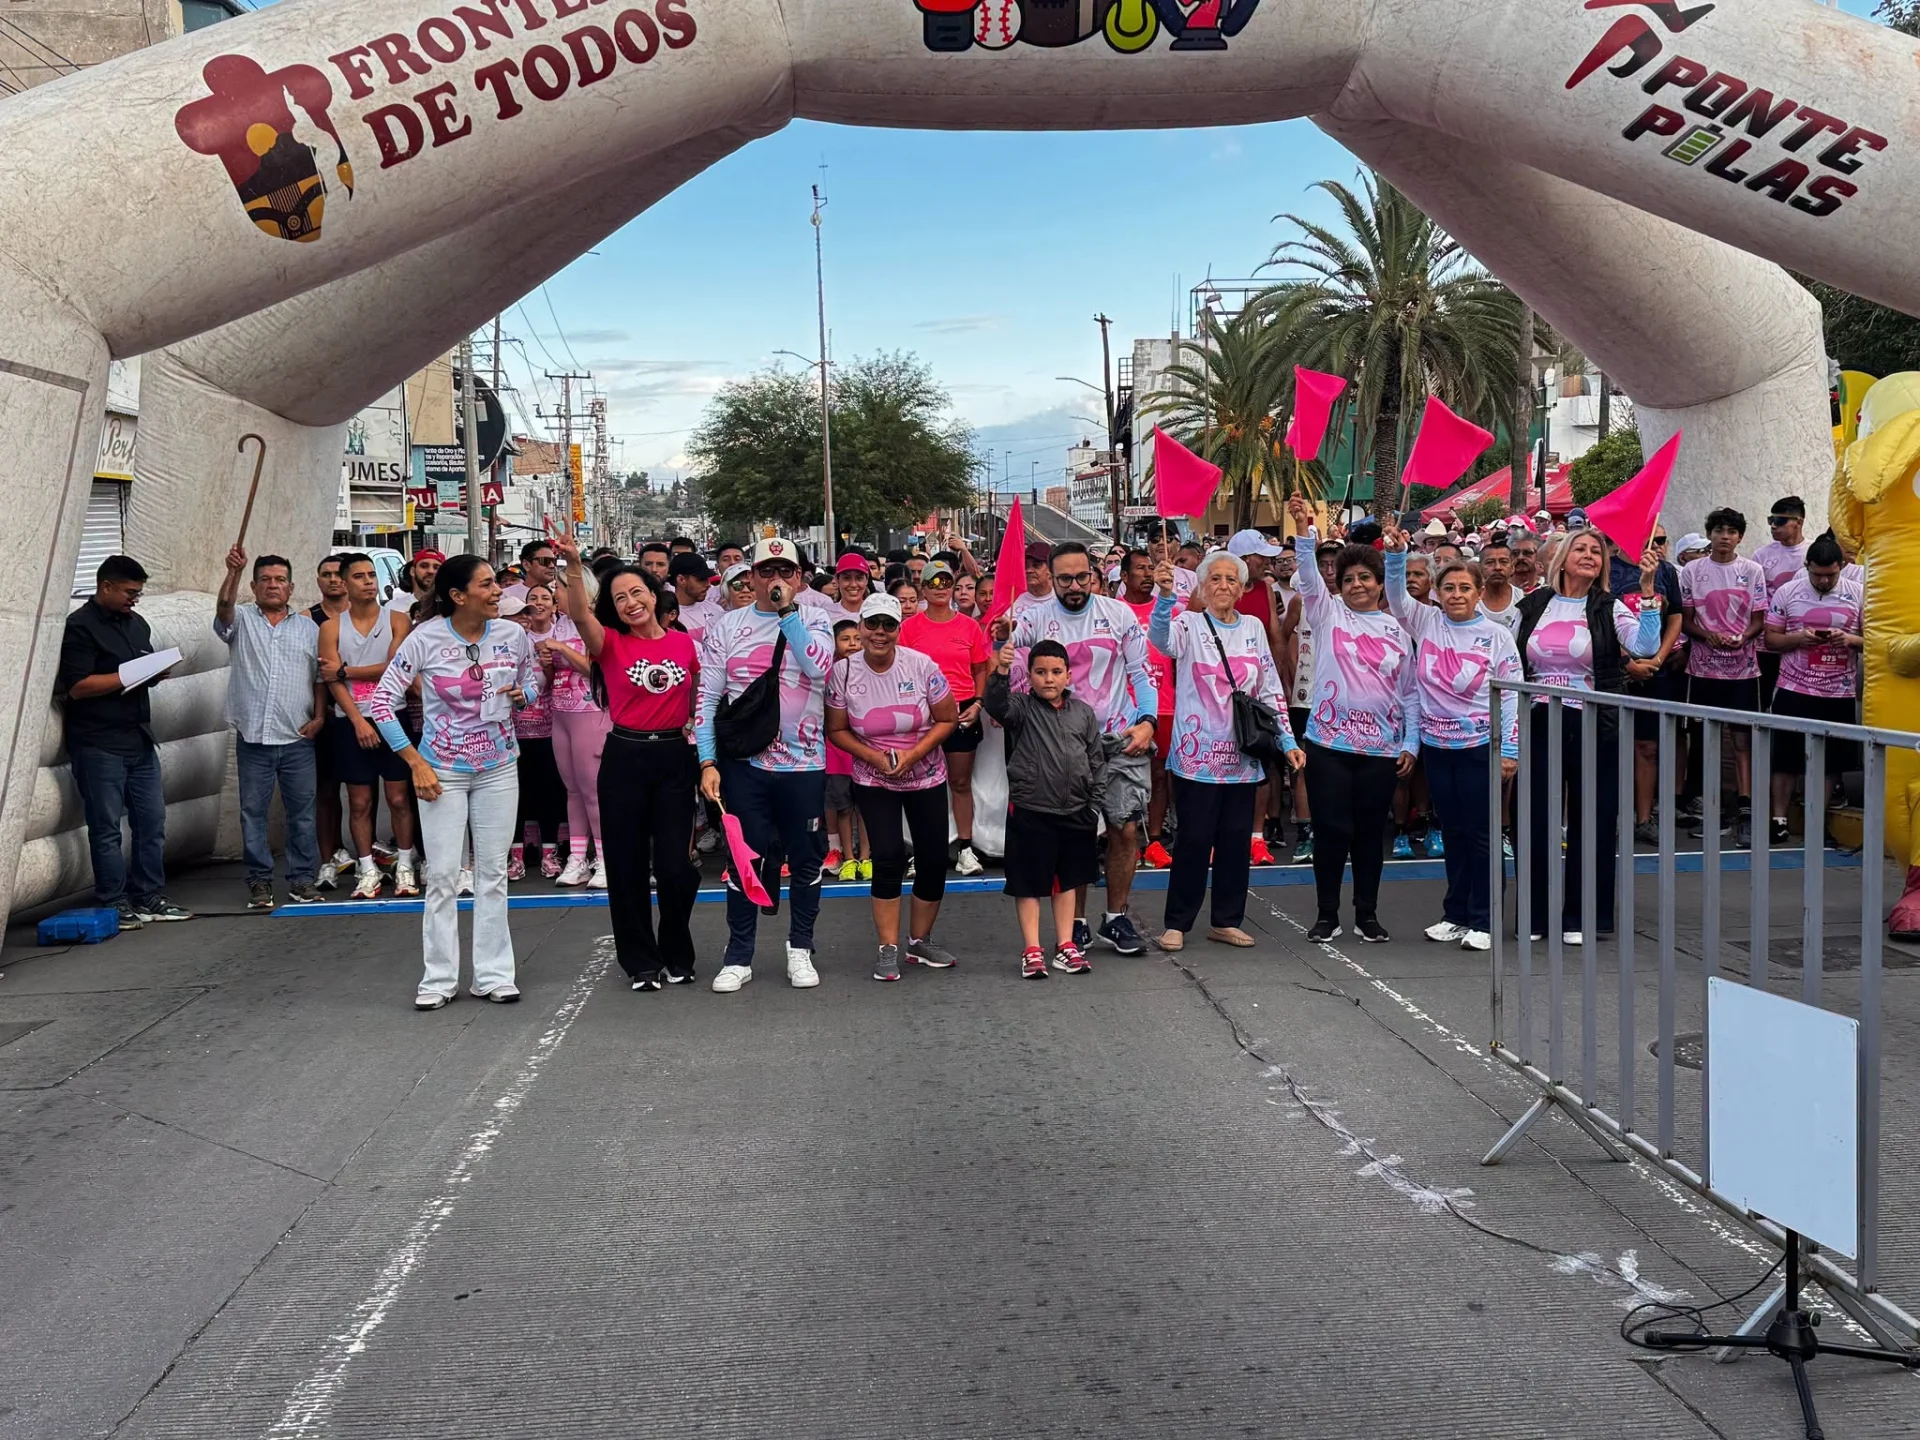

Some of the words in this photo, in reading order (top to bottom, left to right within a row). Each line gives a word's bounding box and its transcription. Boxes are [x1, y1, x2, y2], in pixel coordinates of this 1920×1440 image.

[361, 81, 473, 170] DE
[474, 0, 698, 120] TODOS
[1640, 54, 1889, 176] PONTE
[1706, 656, 1737, 665] CARRERA
[1543, 675, 1569, 687] GRAN
[1348, 708, 1375, 724] GRAN
[1339, 718, 1382, 737] CARRERA
[463, 731, 488, 744] GRAN
[1211, 741, 1236, 753] GRAN
[1202, 751, 1241, 765] CARRERA
